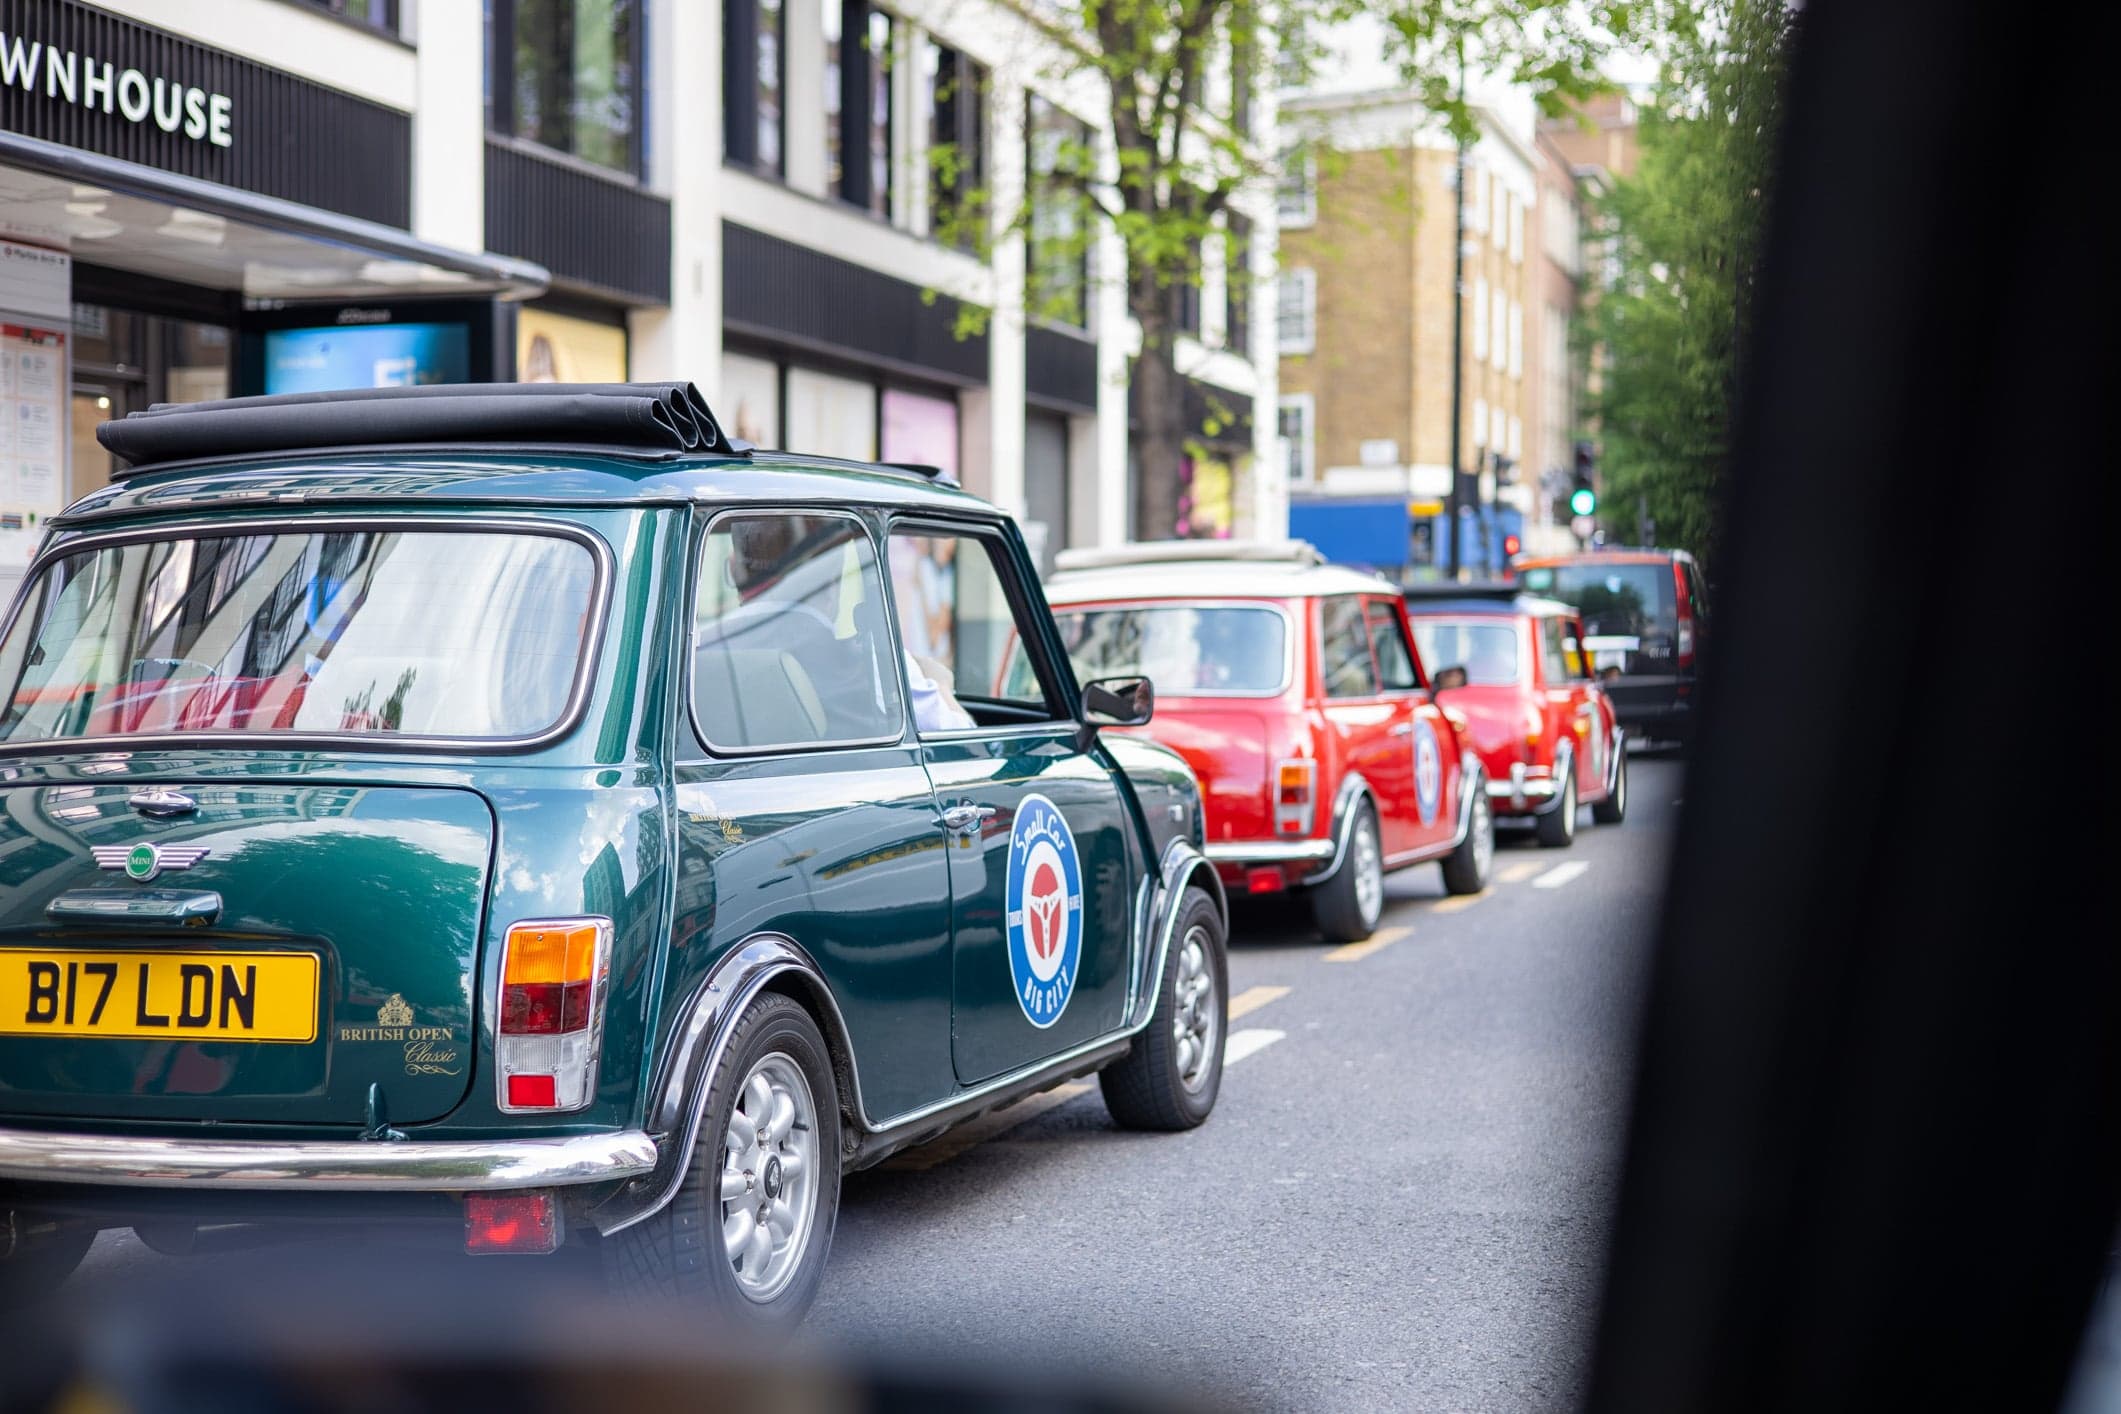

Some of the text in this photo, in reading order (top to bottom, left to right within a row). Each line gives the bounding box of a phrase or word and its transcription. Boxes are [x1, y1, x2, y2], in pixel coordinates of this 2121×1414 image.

[0, 31, 233, 148] WNHOUSE
[130, 856, 151, 865] MINI
[25, 961, 257, 1029] B17 LDN
[1024, 965, 1070, 1014] BIG CITY
[341, 1028, 453, 1041] BRITISH OPEN
[403, 1041, 457, 1063] Classic
